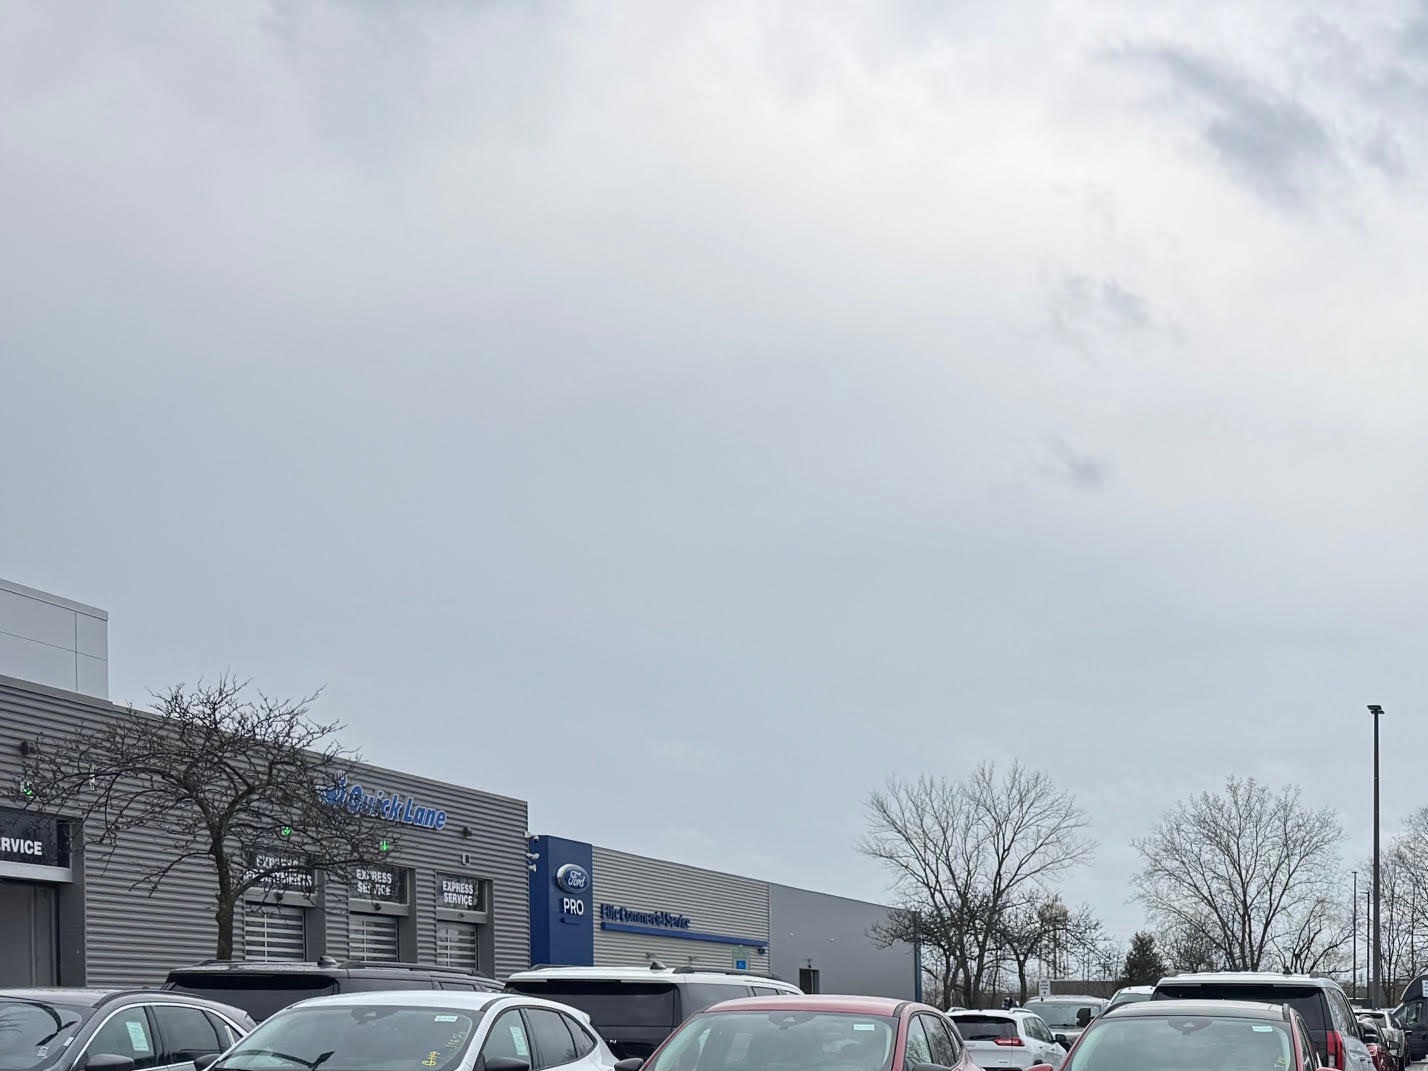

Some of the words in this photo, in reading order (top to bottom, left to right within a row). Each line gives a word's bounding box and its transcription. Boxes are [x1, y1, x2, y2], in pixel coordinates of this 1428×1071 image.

[348, 784, 403, 821] Quick
[403, 796, 448, 830] Lane
[0, 837, 43, 856] RVICE
[442, 881, 474, 895] EXPRESS
[568, 870, 586, 888] Ford
[443, 892, 473, 906] SERVICE
[563, 897, 584, 916] PRO
